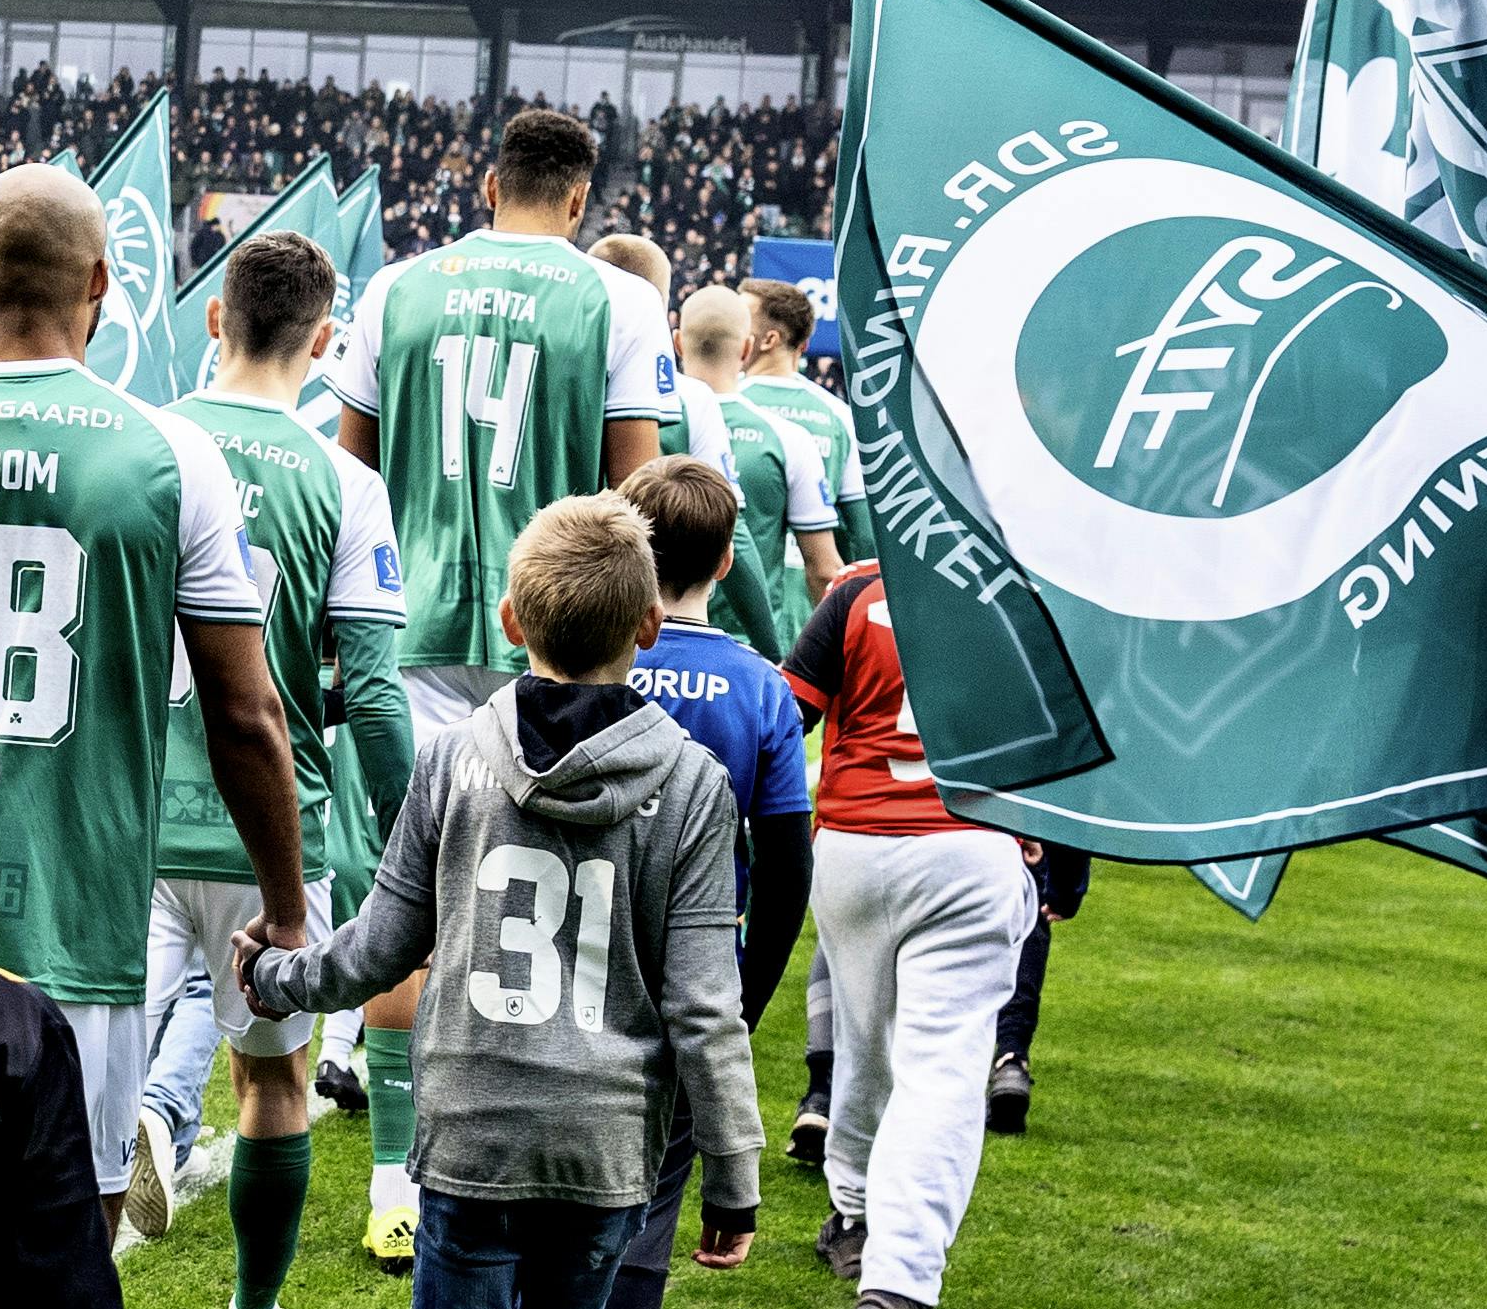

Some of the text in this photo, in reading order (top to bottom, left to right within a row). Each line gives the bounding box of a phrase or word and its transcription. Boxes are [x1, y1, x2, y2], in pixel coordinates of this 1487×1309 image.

[443, 287, 537, 325] EMENTA
[432, 332, 540, 491] 14
[468, 843, 616, 1034] 31
